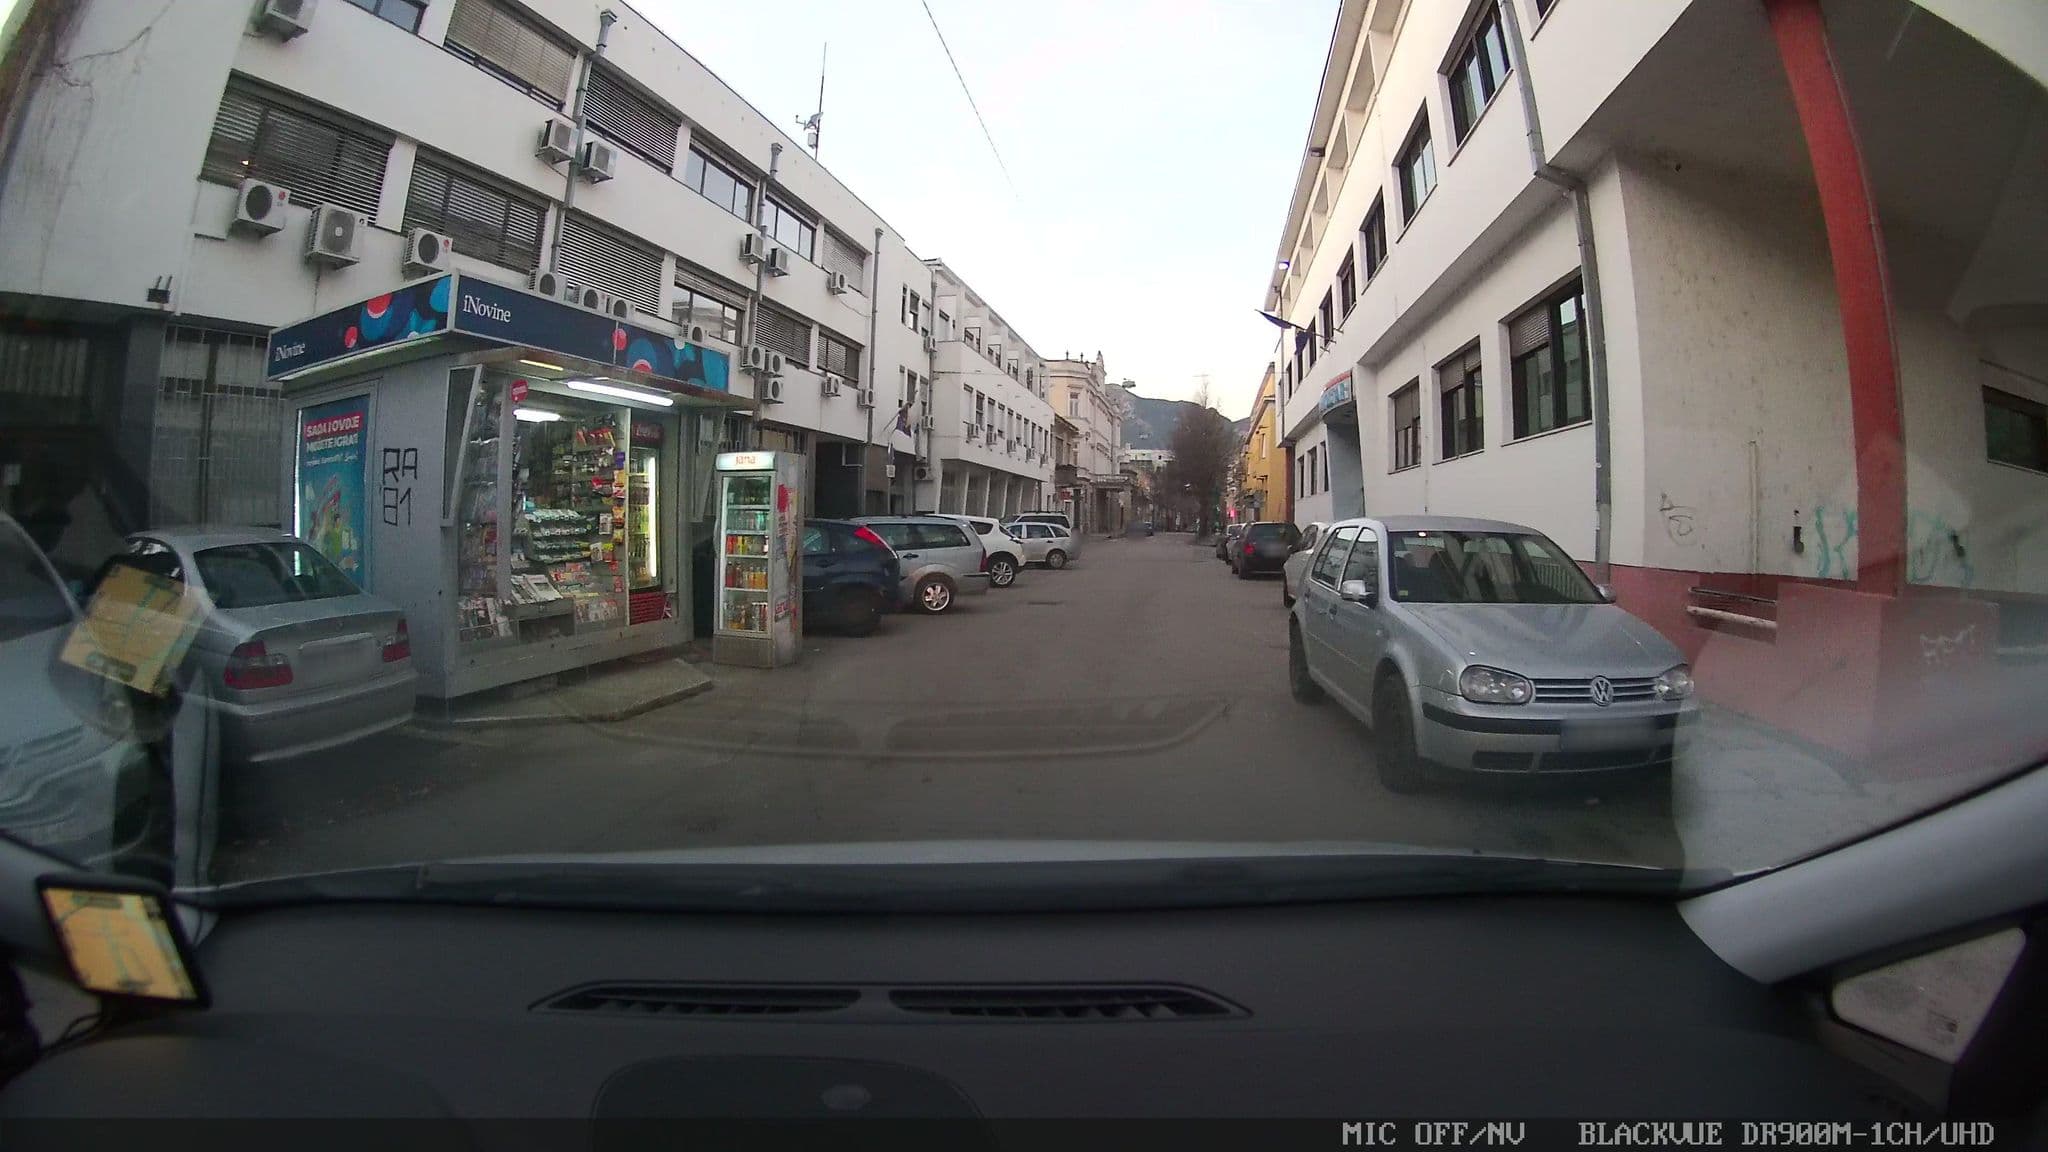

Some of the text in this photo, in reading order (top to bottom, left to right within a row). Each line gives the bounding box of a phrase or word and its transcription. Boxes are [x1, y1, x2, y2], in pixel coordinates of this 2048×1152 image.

[463, 294, 511, 323] iNovine
[275, 342, 306, 362] iNovine
[383, 448, 417, 485] RA
